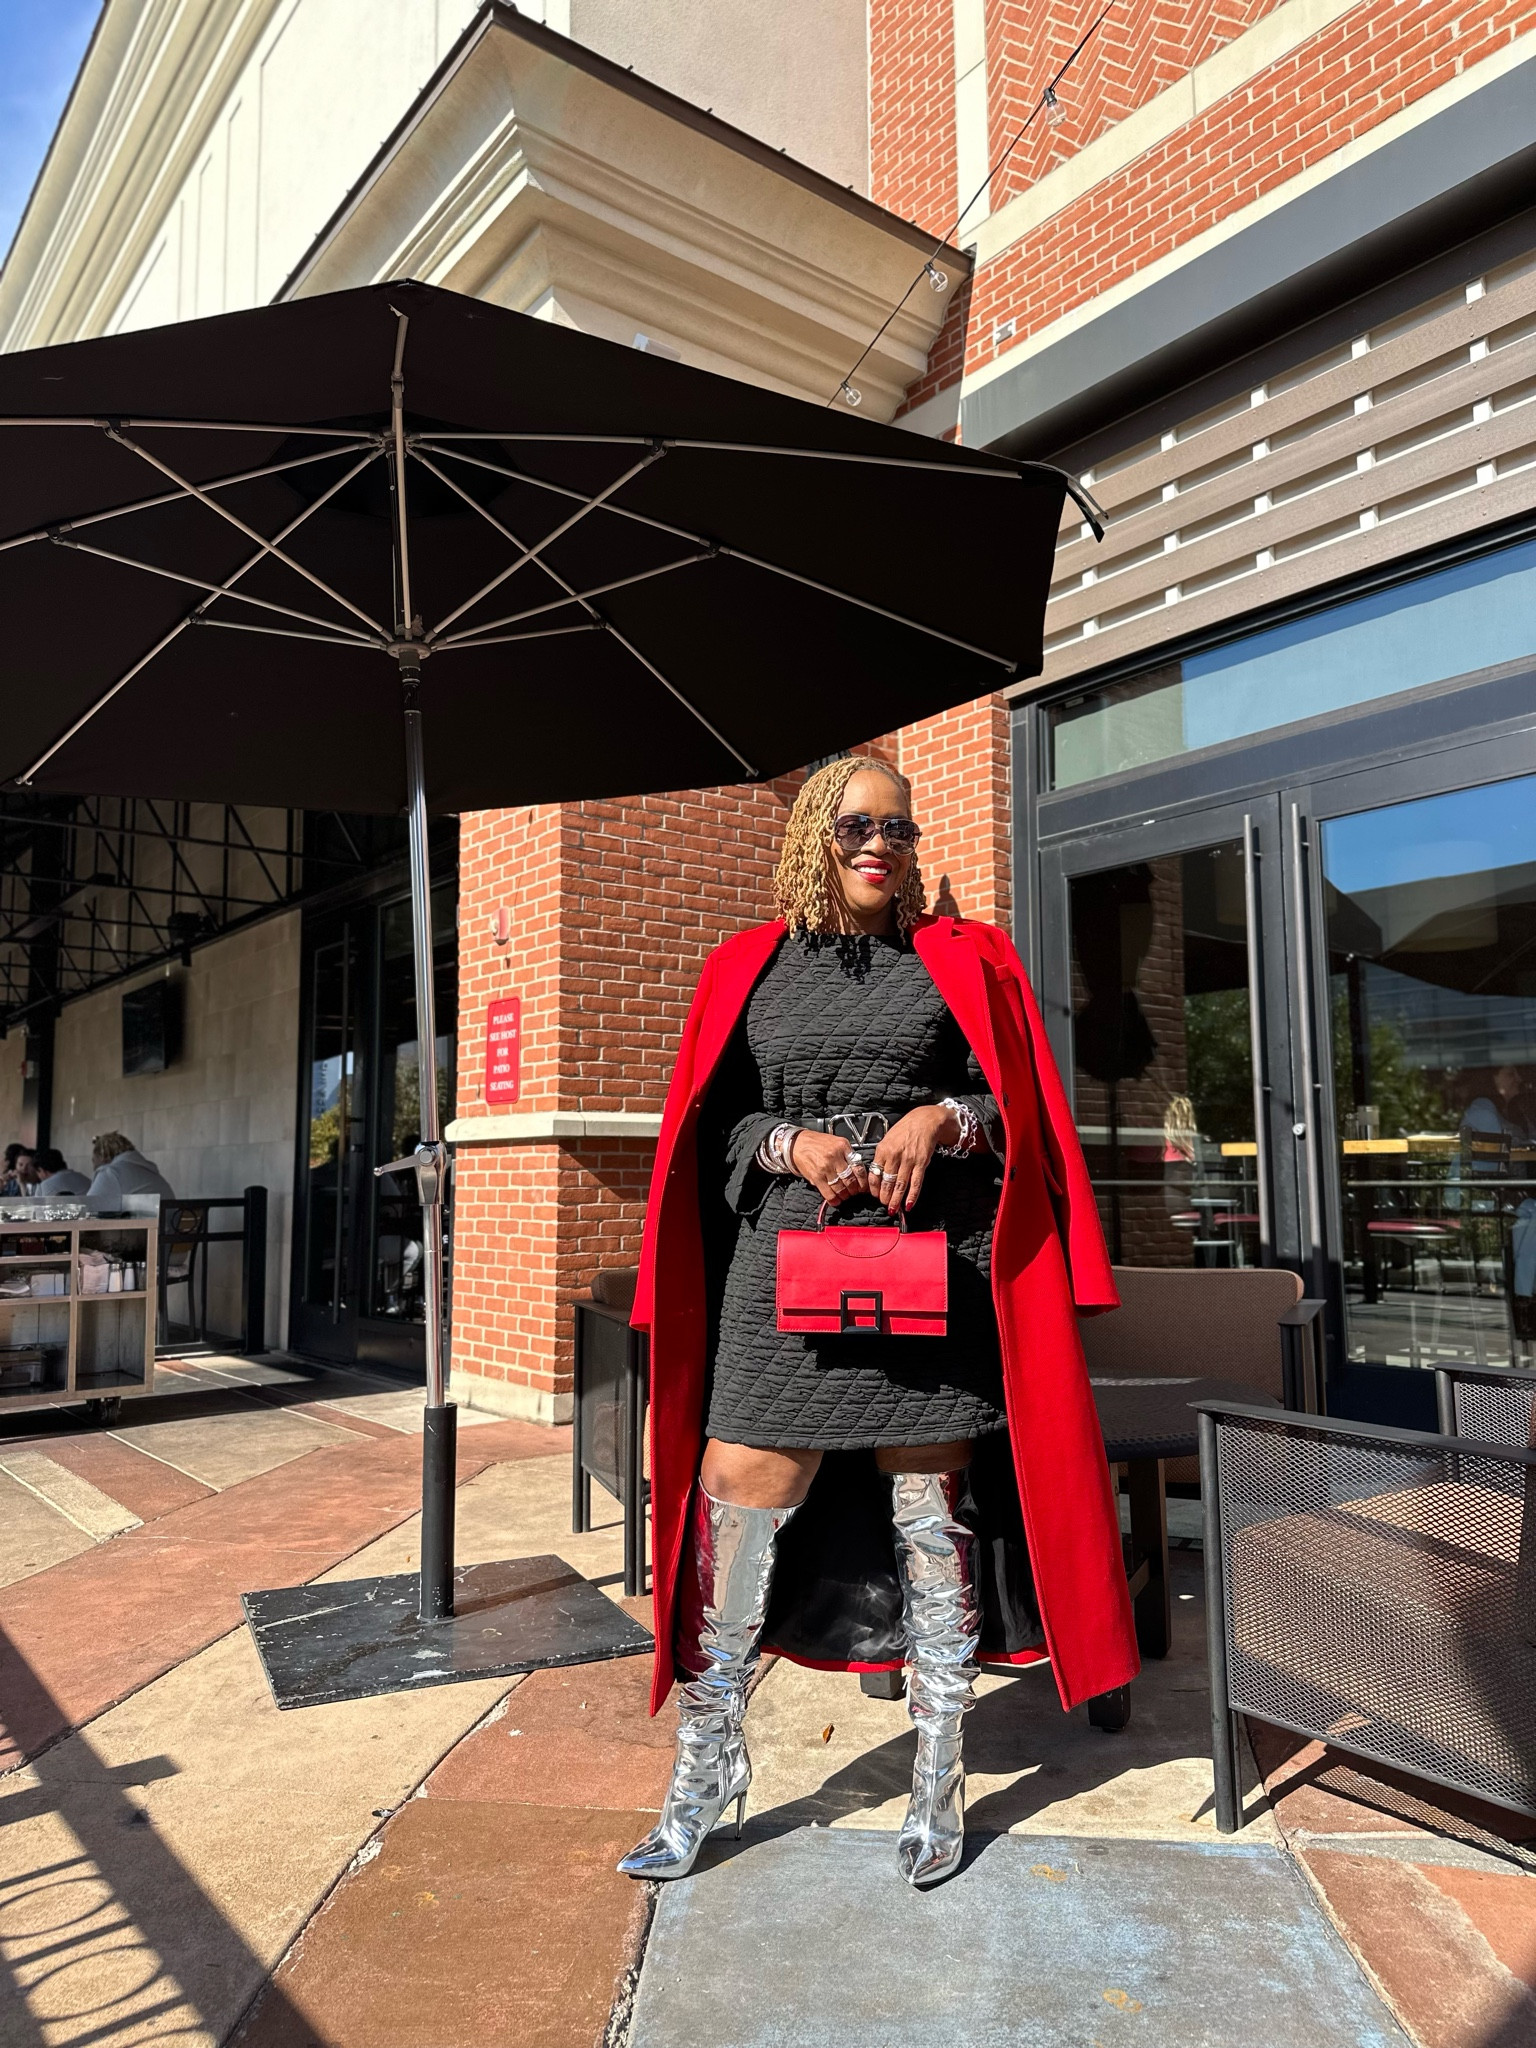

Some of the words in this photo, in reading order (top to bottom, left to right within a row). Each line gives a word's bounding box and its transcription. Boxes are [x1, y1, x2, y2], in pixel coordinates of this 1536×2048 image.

[493, 1013, 514, 1024] PLEASE
[489, 1032, 501, 1042] SEE
[501, 1029, 516, 1040] HOST
[496, 1047, 509, 1057] FOR
[493, 1064, 510, 1074] PATIO
[490, 1080, 514, 1091] SEATING
